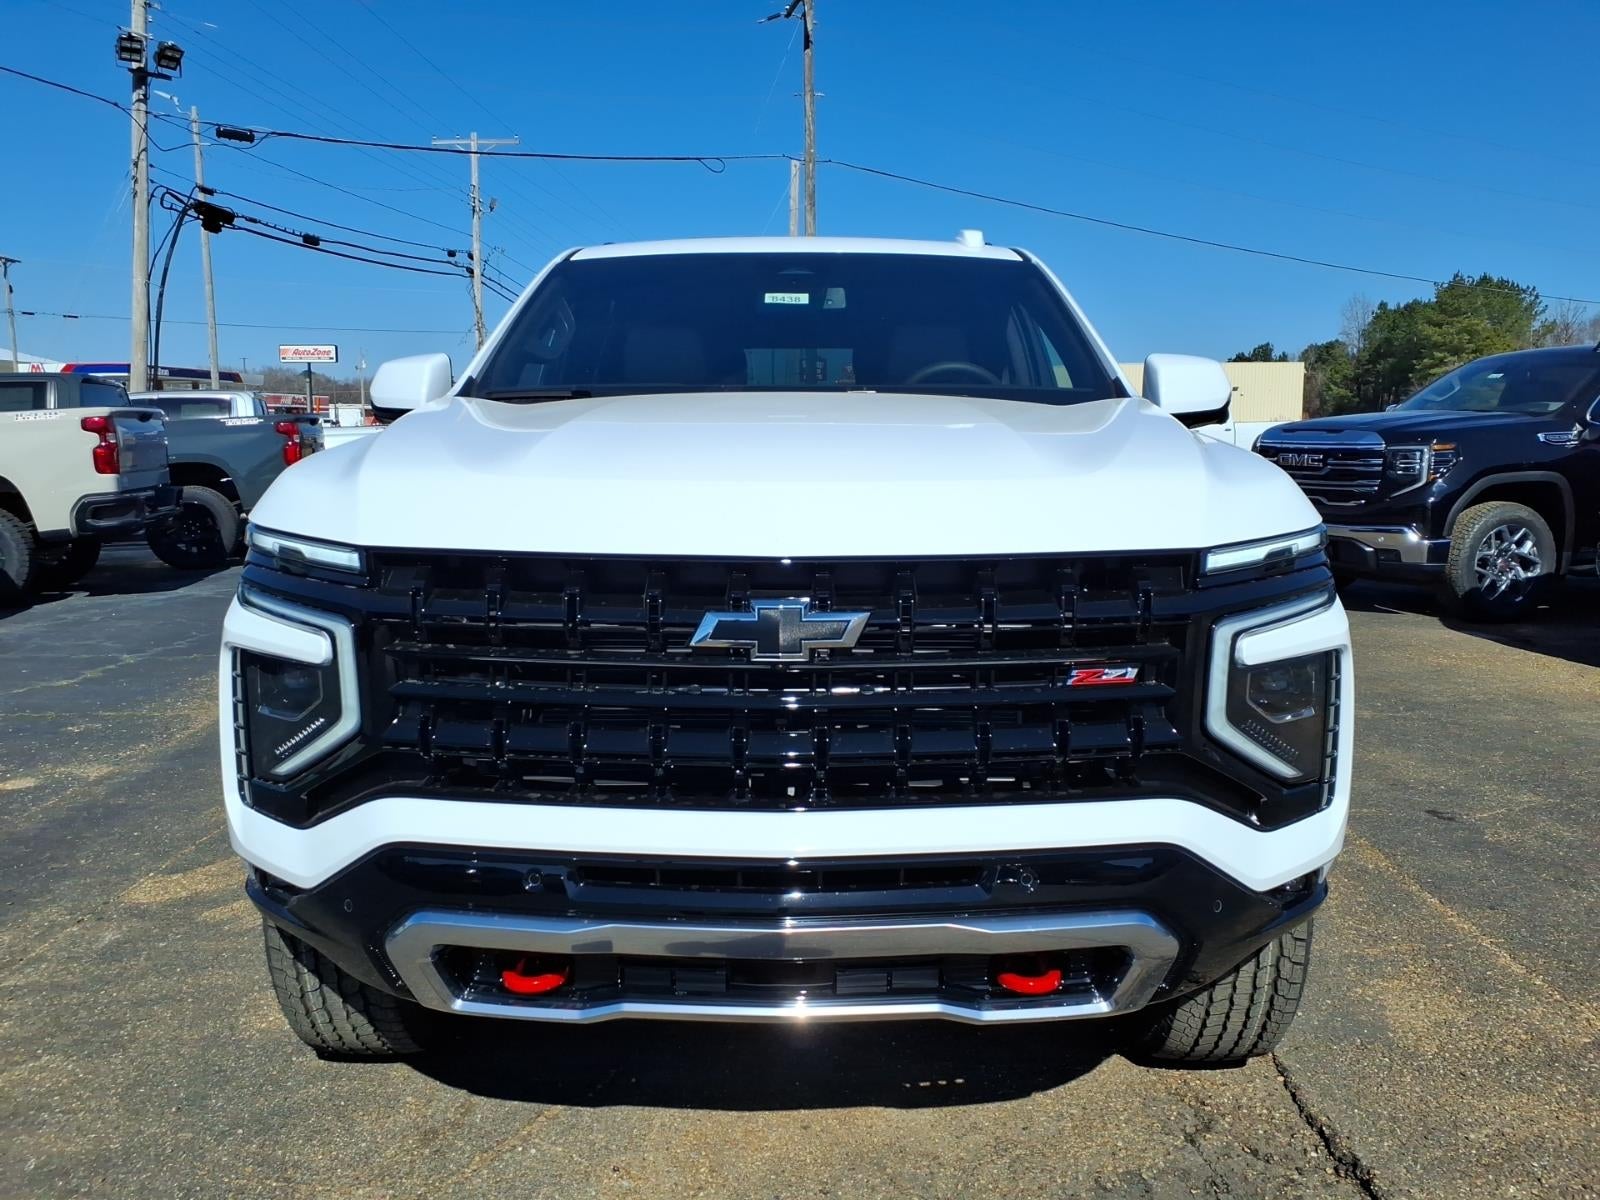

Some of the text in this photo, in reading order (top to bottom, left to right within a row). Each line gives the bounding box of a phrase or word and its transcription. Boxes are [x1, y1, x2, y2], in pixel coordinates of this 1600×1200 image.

[291, 347, 333, 357] AutoZone
[1278, 453, 1323, 467] GMC
[1066, 667, 1139, 688] Z71
